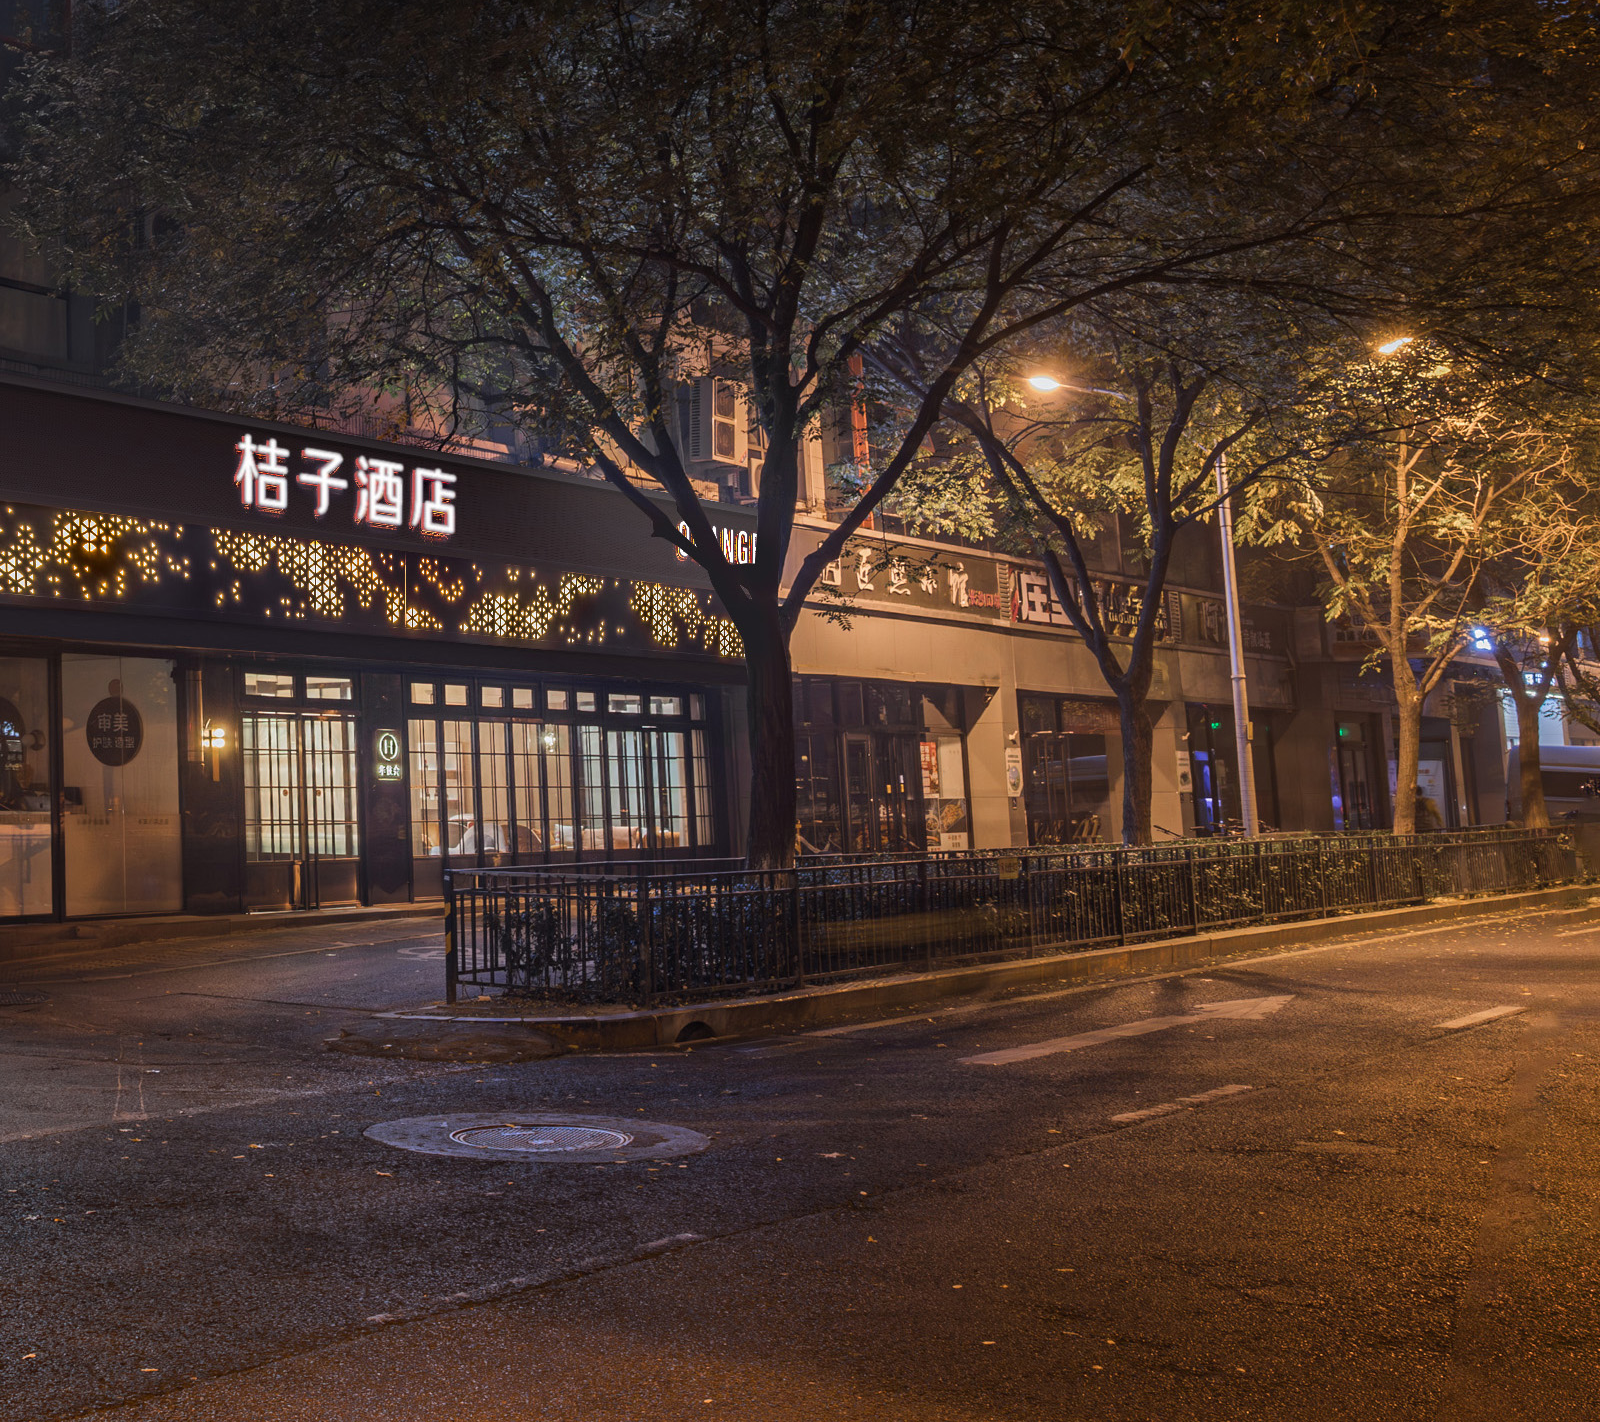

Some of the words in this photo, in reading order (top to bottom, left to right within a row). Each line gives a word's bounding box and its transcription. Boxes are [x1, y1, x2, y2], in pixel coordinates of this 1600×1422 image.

[236, 433, 457, 535] 桔子酒店
[97, 713, 129, 732] 审美
